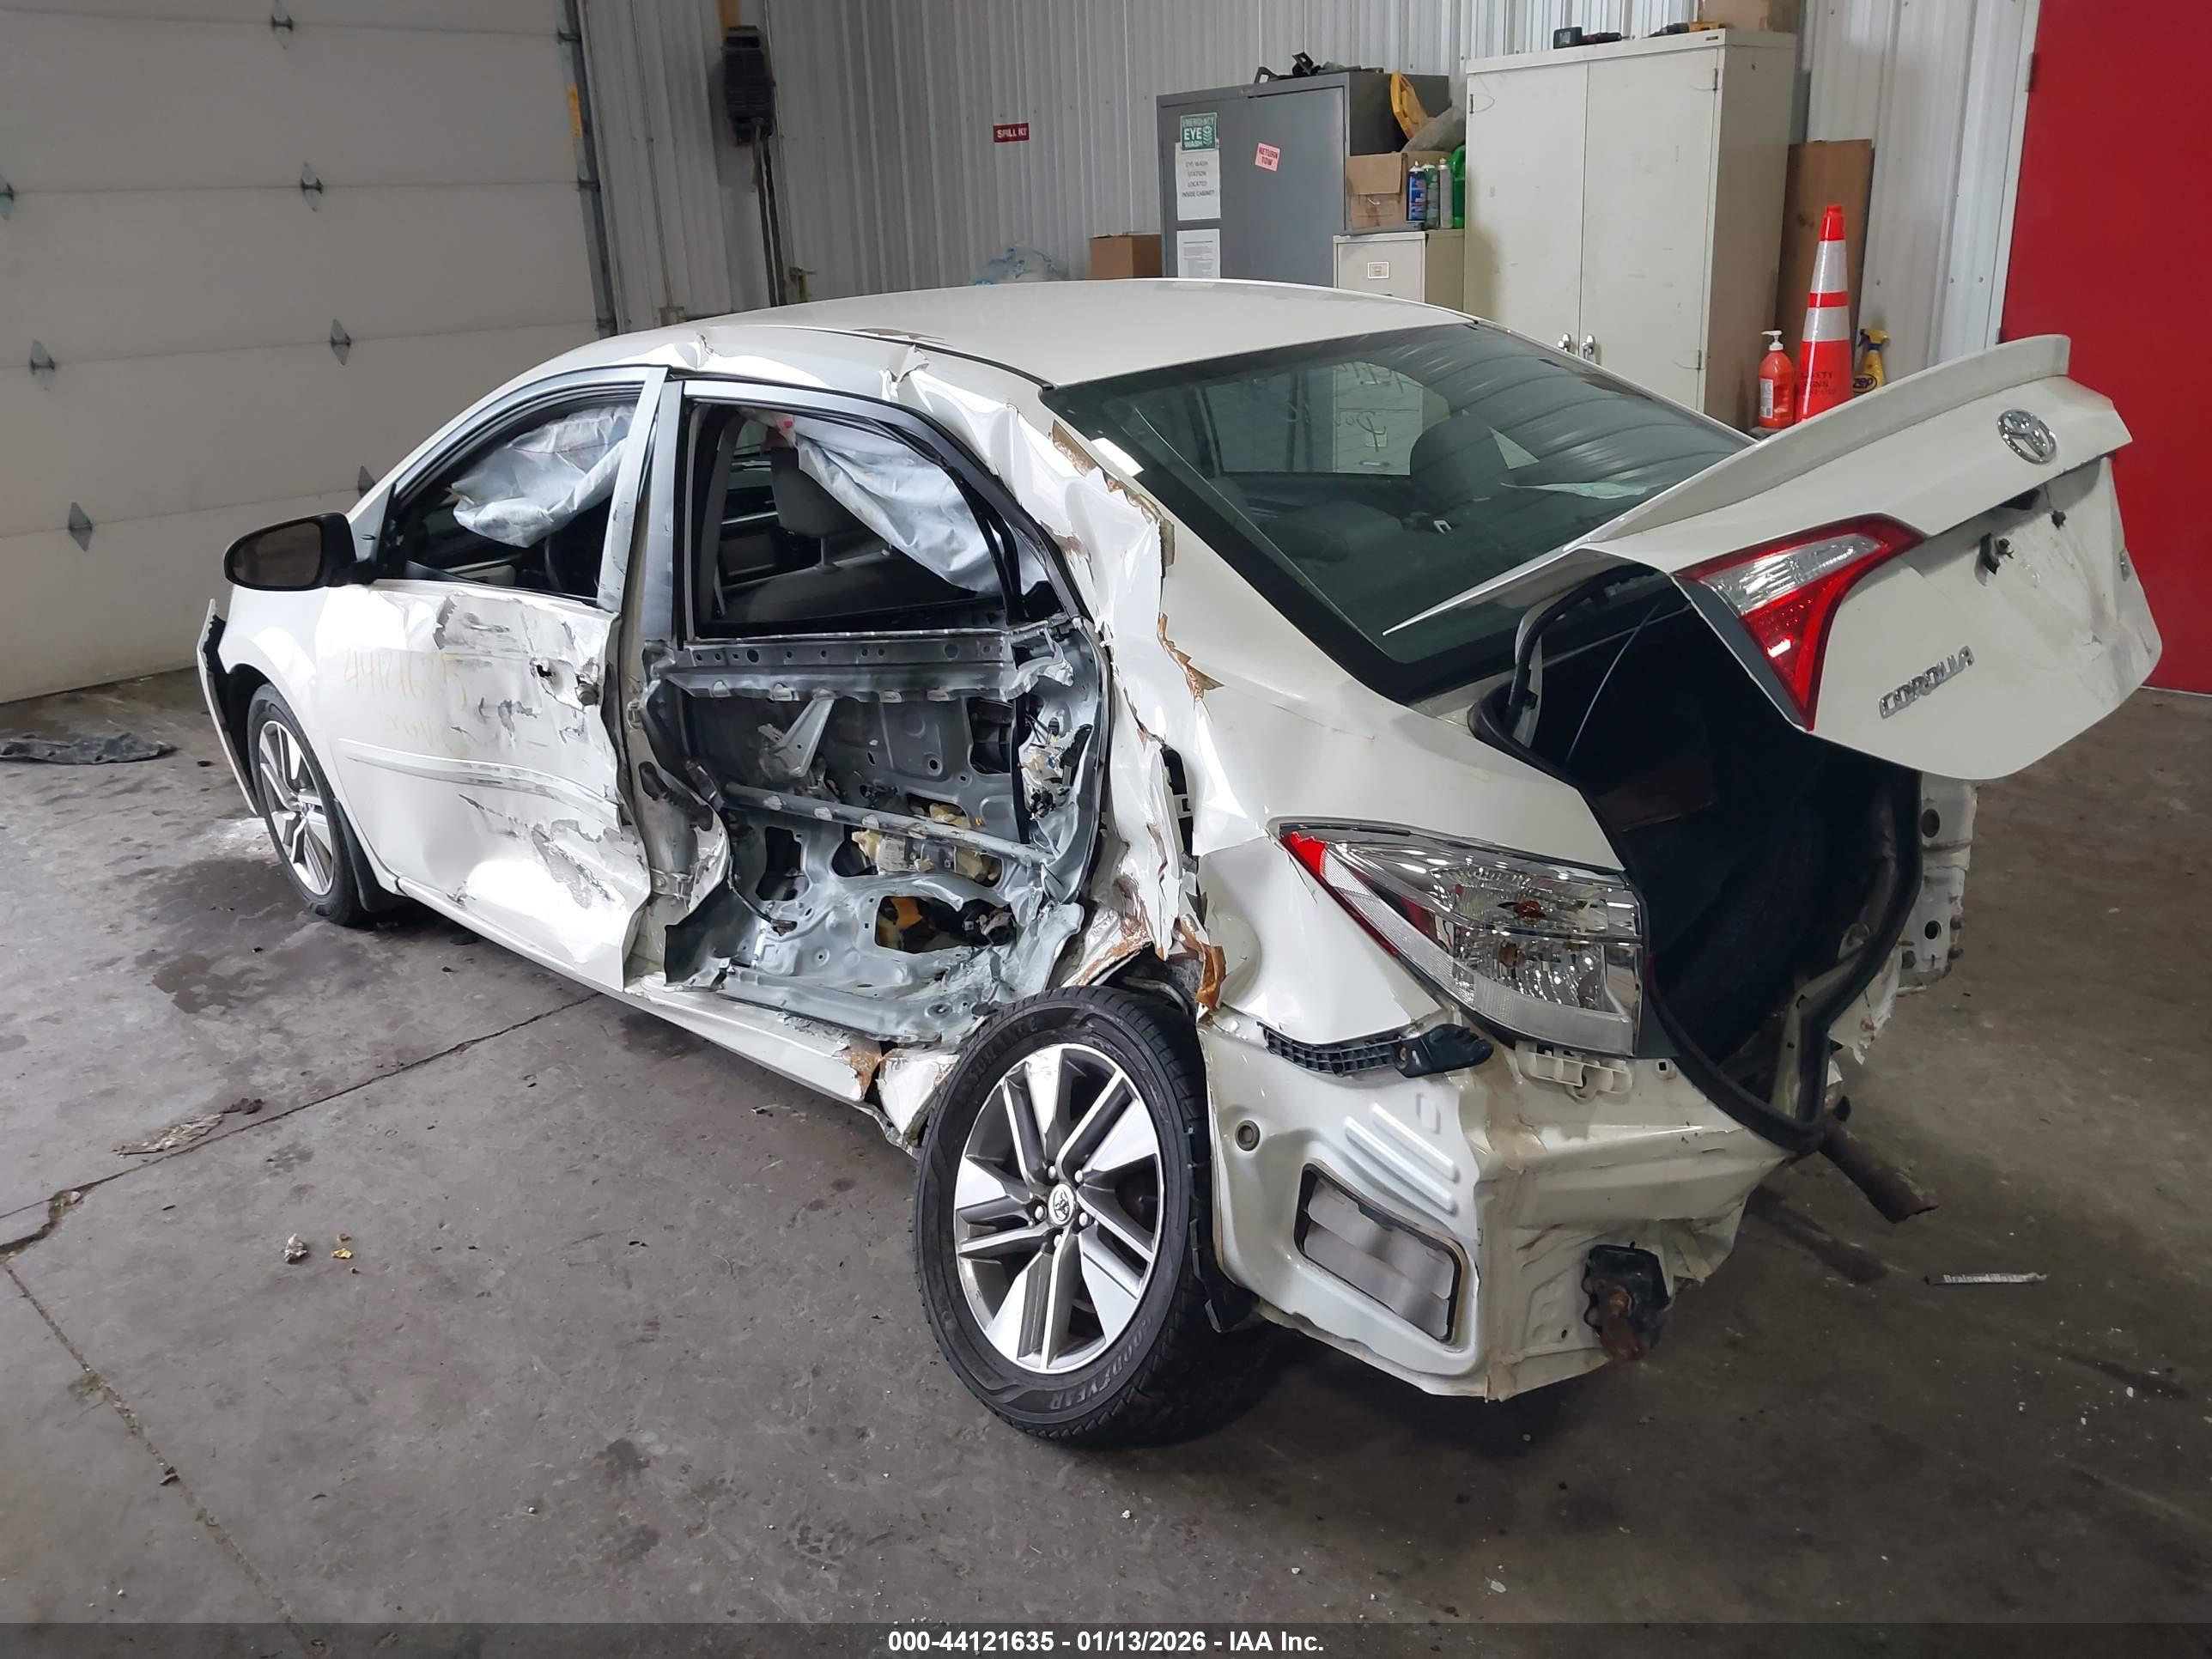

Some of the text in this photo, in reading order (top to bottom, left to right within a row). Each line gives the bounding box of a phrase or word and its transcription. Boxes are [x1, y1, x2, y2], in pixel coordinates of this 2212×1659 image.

[997, 127, 1027, 138] SPILL KIT
[1184, 127, 1202, 141] EYE
[1259, 148, 1278, 159] RETURN
[1879, 645, 1975, 720] COROLLA
